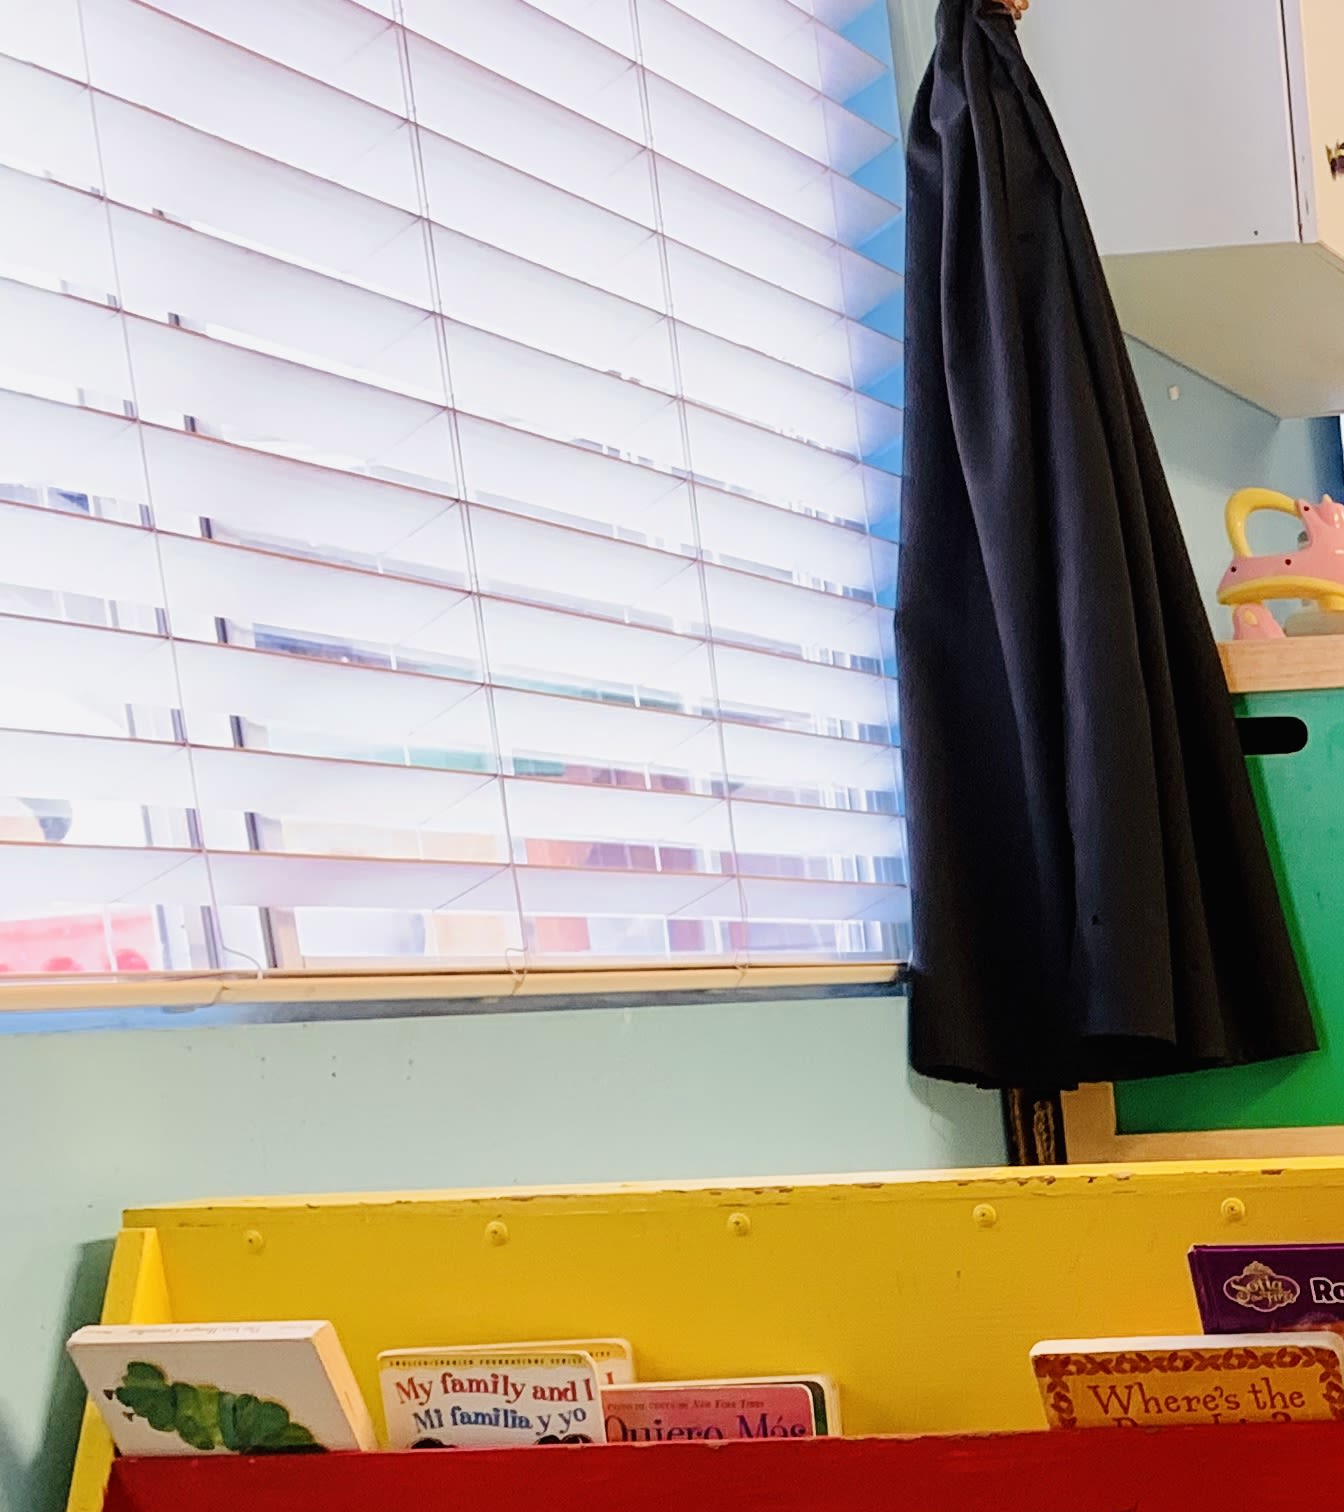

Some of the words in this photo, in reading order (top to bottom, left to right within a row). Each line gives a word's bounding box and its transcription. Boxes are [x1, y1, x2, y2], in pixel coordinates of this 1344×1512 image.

[395, 1375, 434, 1406] My
[440, 1371, 527, 1404] family
[531, 1379, 578, 1402] and
[584, 1377, 597, 1402] I
[1086, 1381, 1242, 1416] Where's
[1247, 1377, 1306, 1411] the
[412, 1407, 445, 1434] Mi
[450, 1405, 534, 1431] familia
[535, 1413, 553, 1437] y
[558, 1407, 588, 1435] yo
